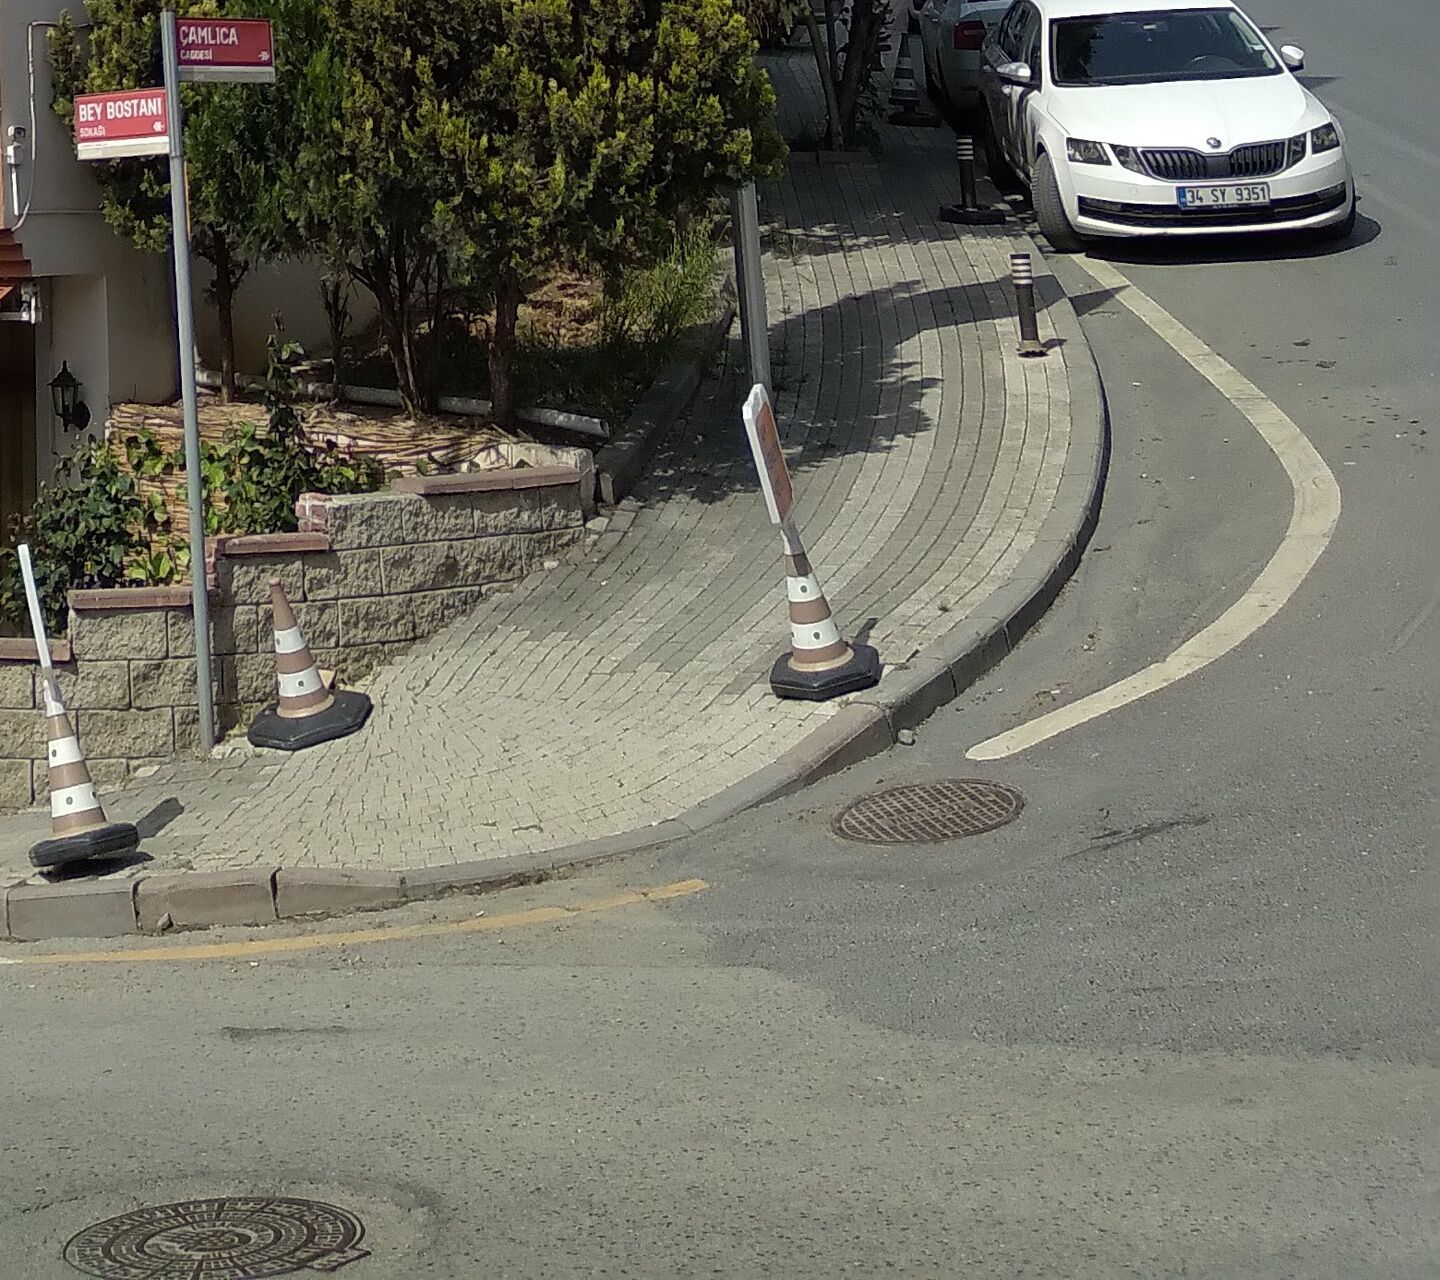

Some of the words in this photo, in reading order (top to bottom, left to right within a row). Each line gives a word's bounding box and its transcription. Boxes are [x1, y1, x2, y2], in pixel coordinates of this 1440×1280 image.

[179, 25, 239, 47] ÇAMLICA
[78, 103, 102, 123] BEY
[106, 96, 163, 120] BOSTANI
[1186, 189, 1204, 204] 34
[1210, 188, 1227, 203] SY
[1234, 186, 1267, 202] 9351
